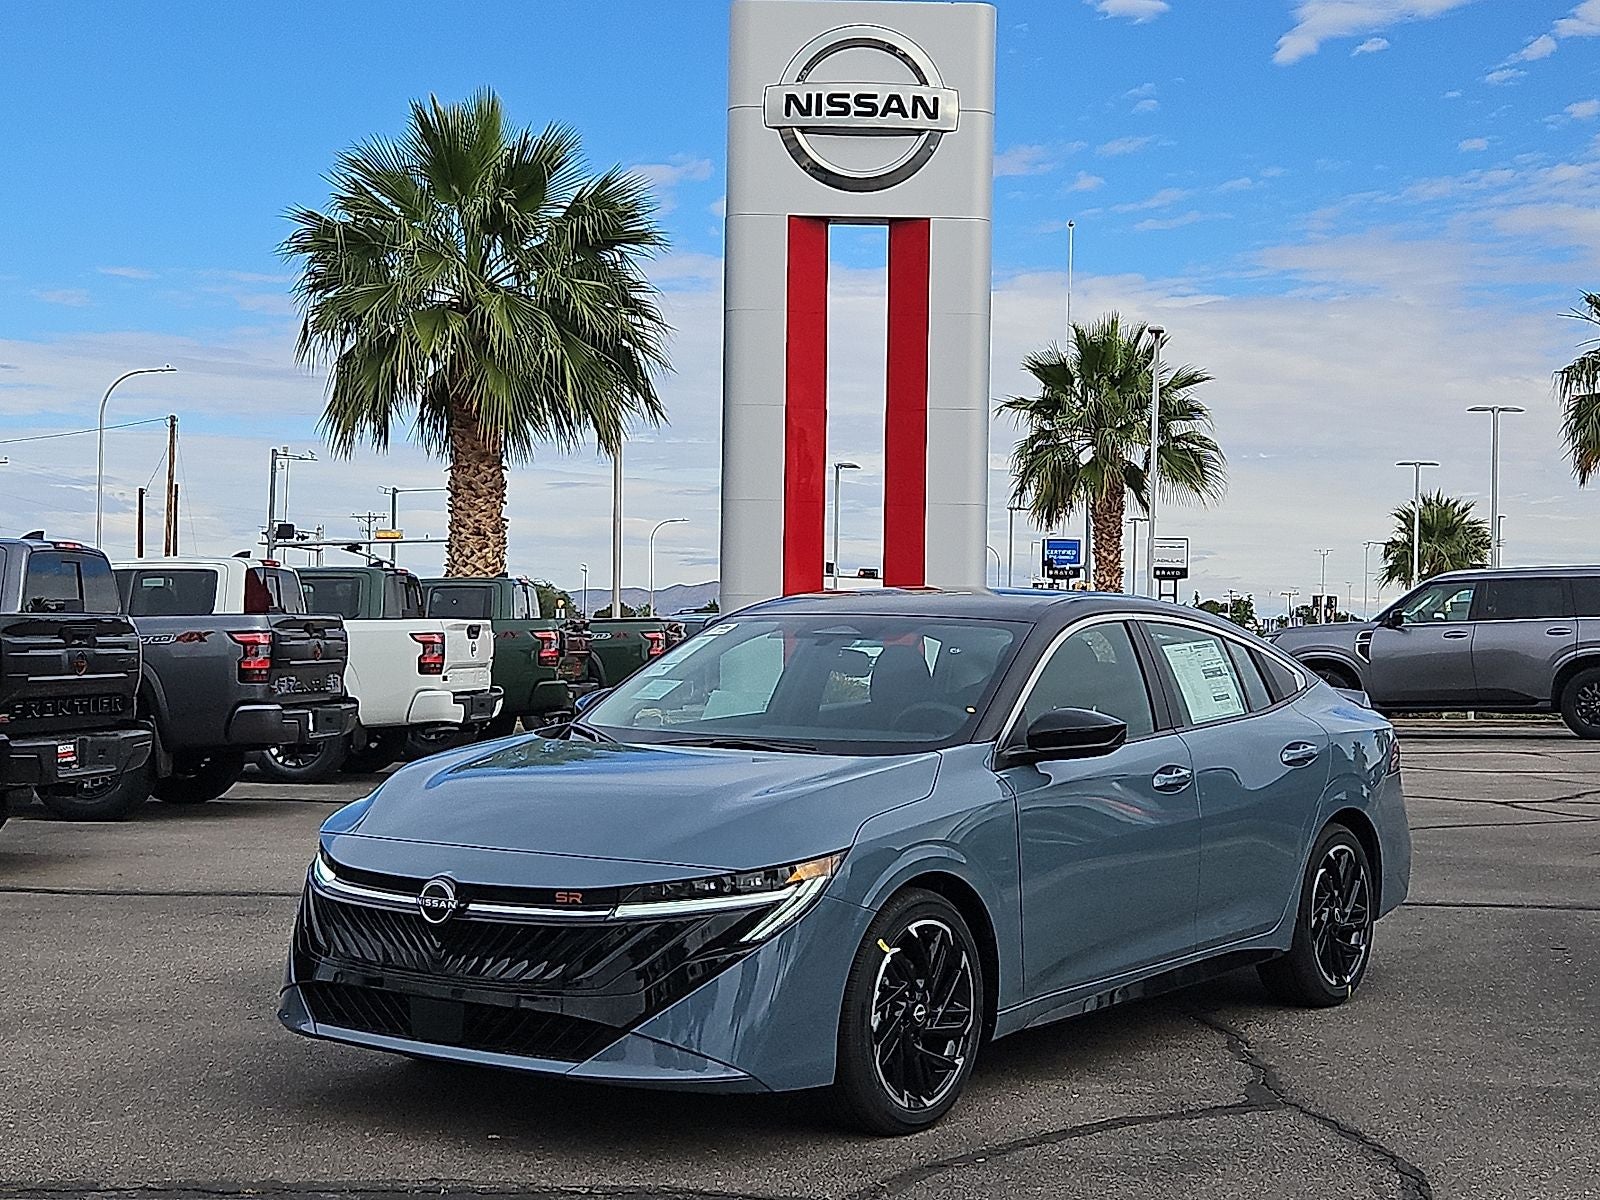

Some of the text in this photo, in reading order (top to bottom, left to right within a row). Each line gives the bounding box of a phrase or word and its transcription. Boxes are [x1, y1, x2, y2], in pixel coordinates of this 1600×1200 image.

[784, 92, 940, 120] NISSAN
[9, 697, 123, 719] FRONTIER
[415, 896, 458, 910] NISSAN
[555, 891, 583, 904] SR
